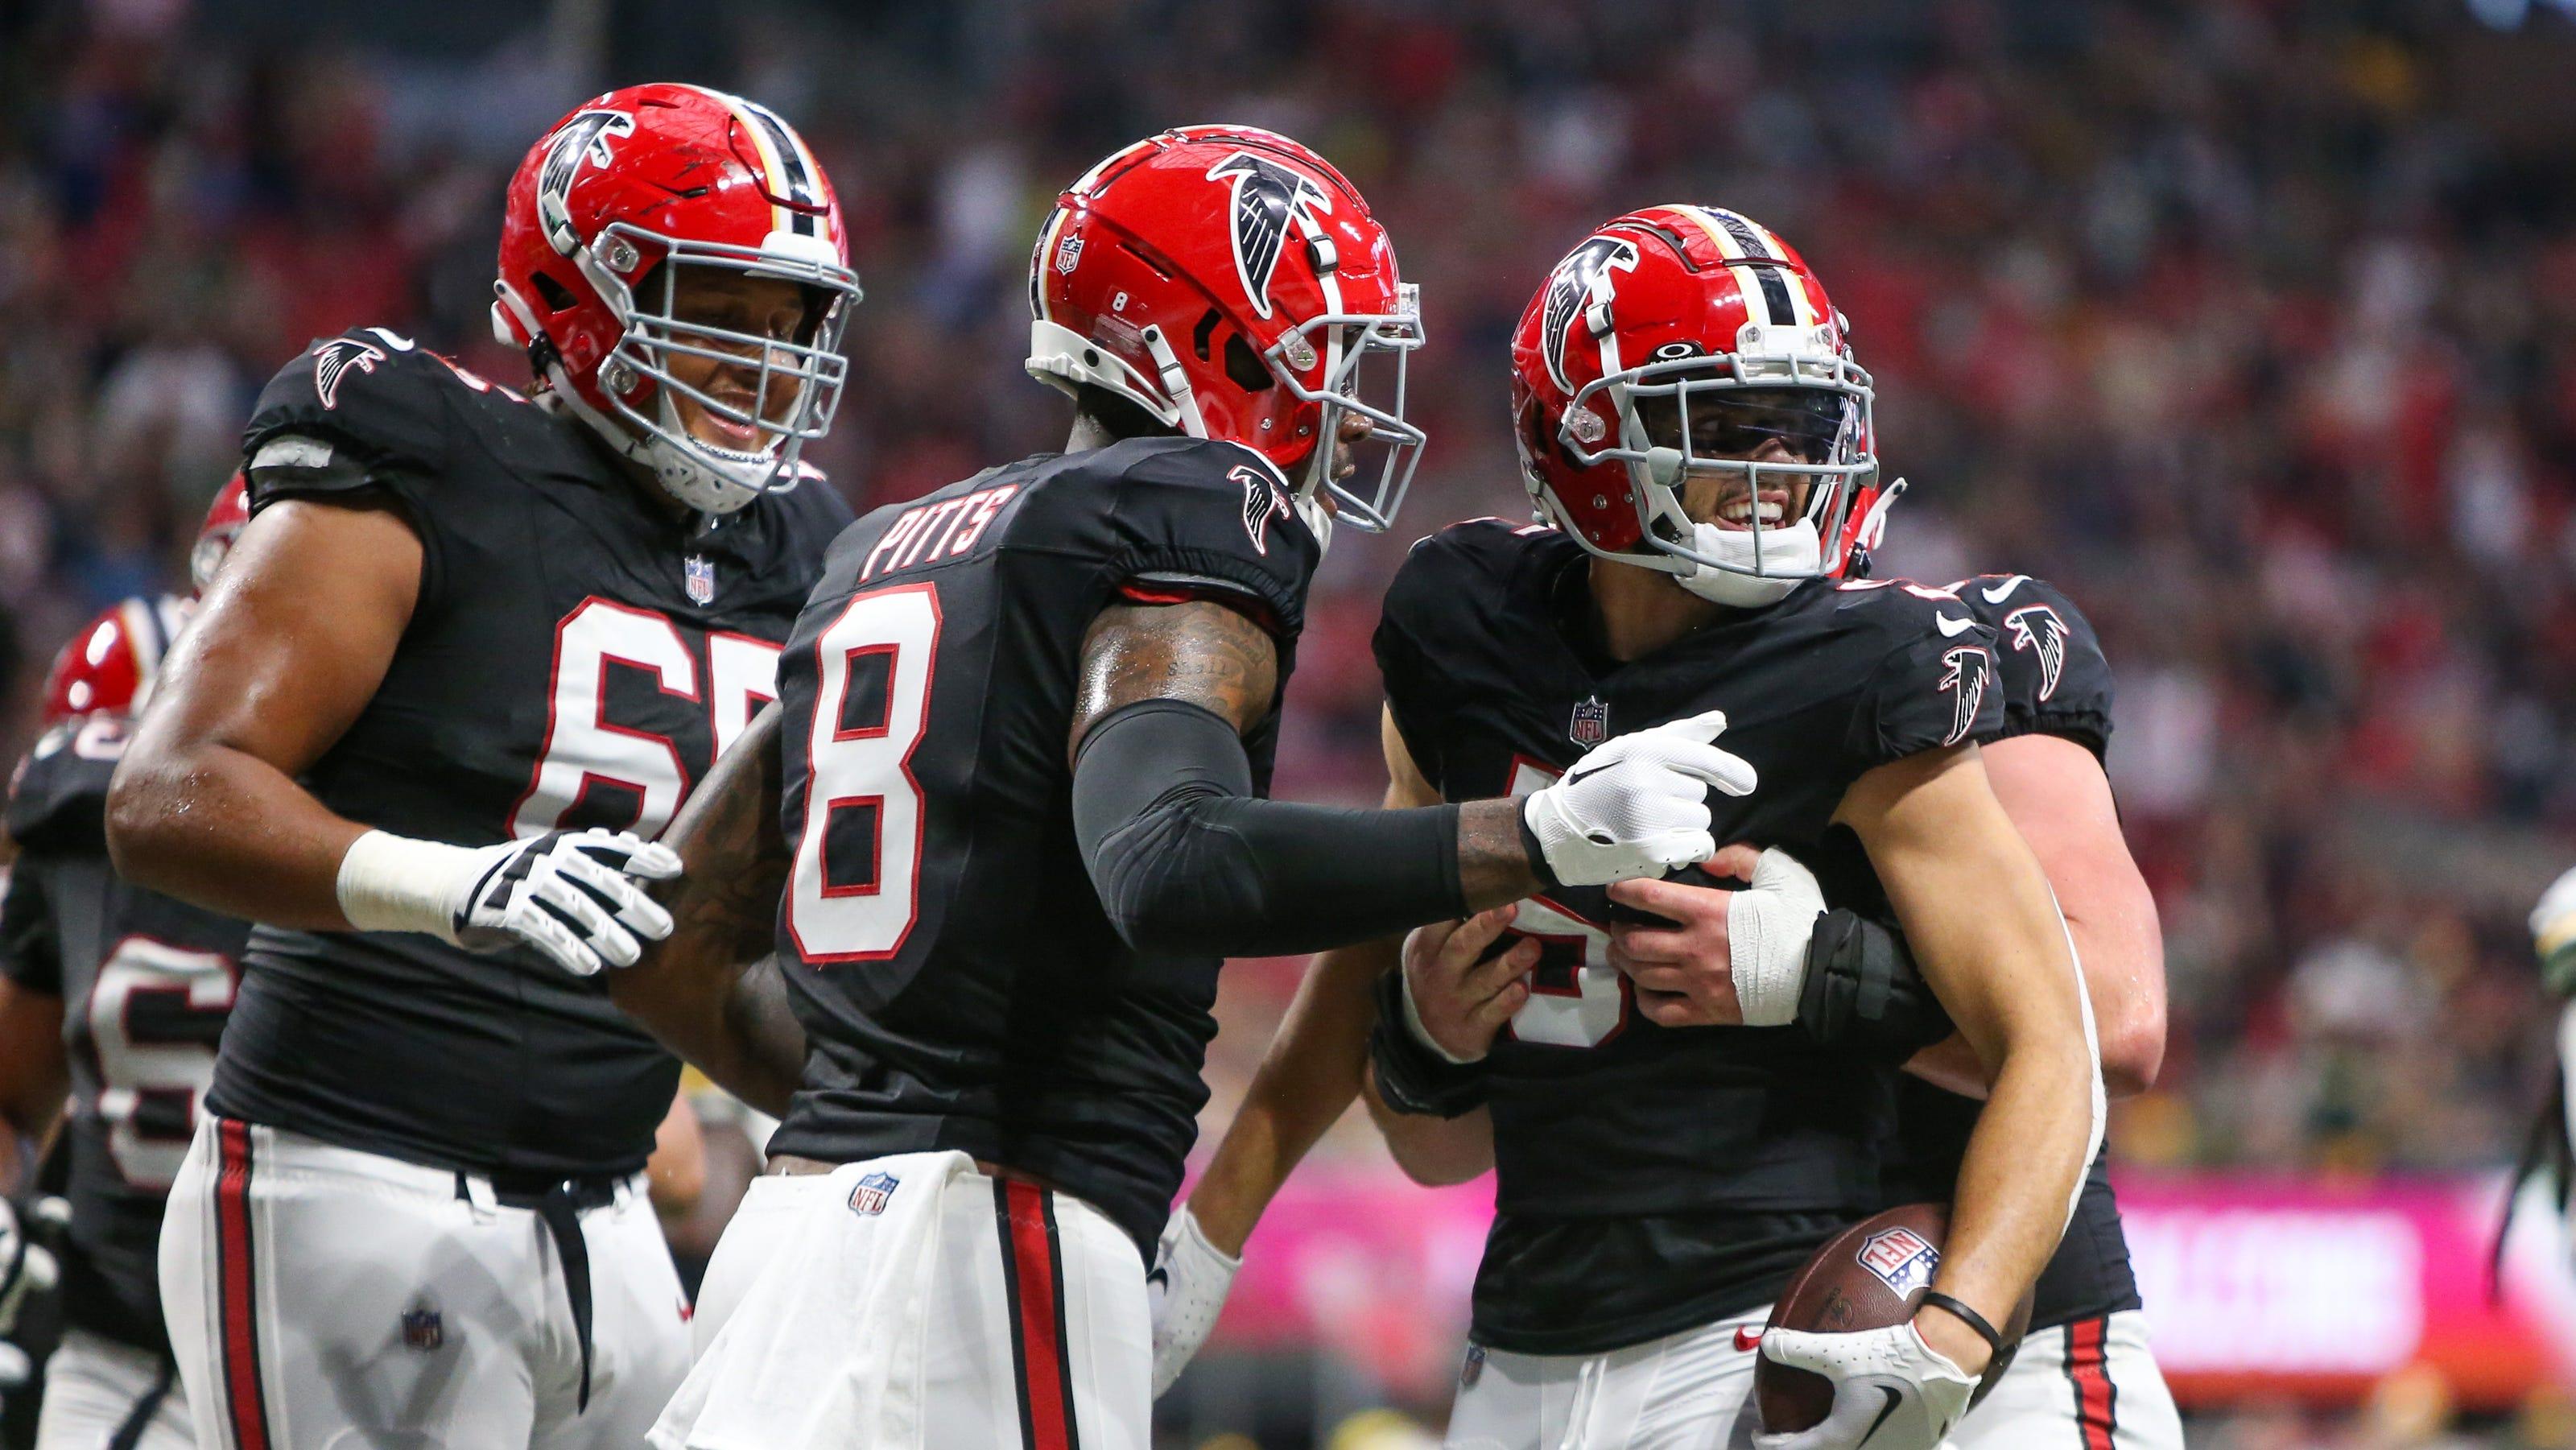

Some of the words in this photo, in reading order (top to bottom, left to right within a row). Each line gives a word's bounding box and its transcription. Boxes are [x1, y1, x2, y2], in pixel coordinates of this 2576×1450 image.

[1113, 291, 1129, 312] 8
[858, 484, 1019, 576] PITTS
[690, 576, 709, 597] NFL
[1575, 720, 1600, 740] NFL
[786, 581, 943, 965] 8
[87, 932, 237, 1189] 6
[852, 1188, 883, 1212] NFL
[1864, 1232, 1922, 1270] NFL
